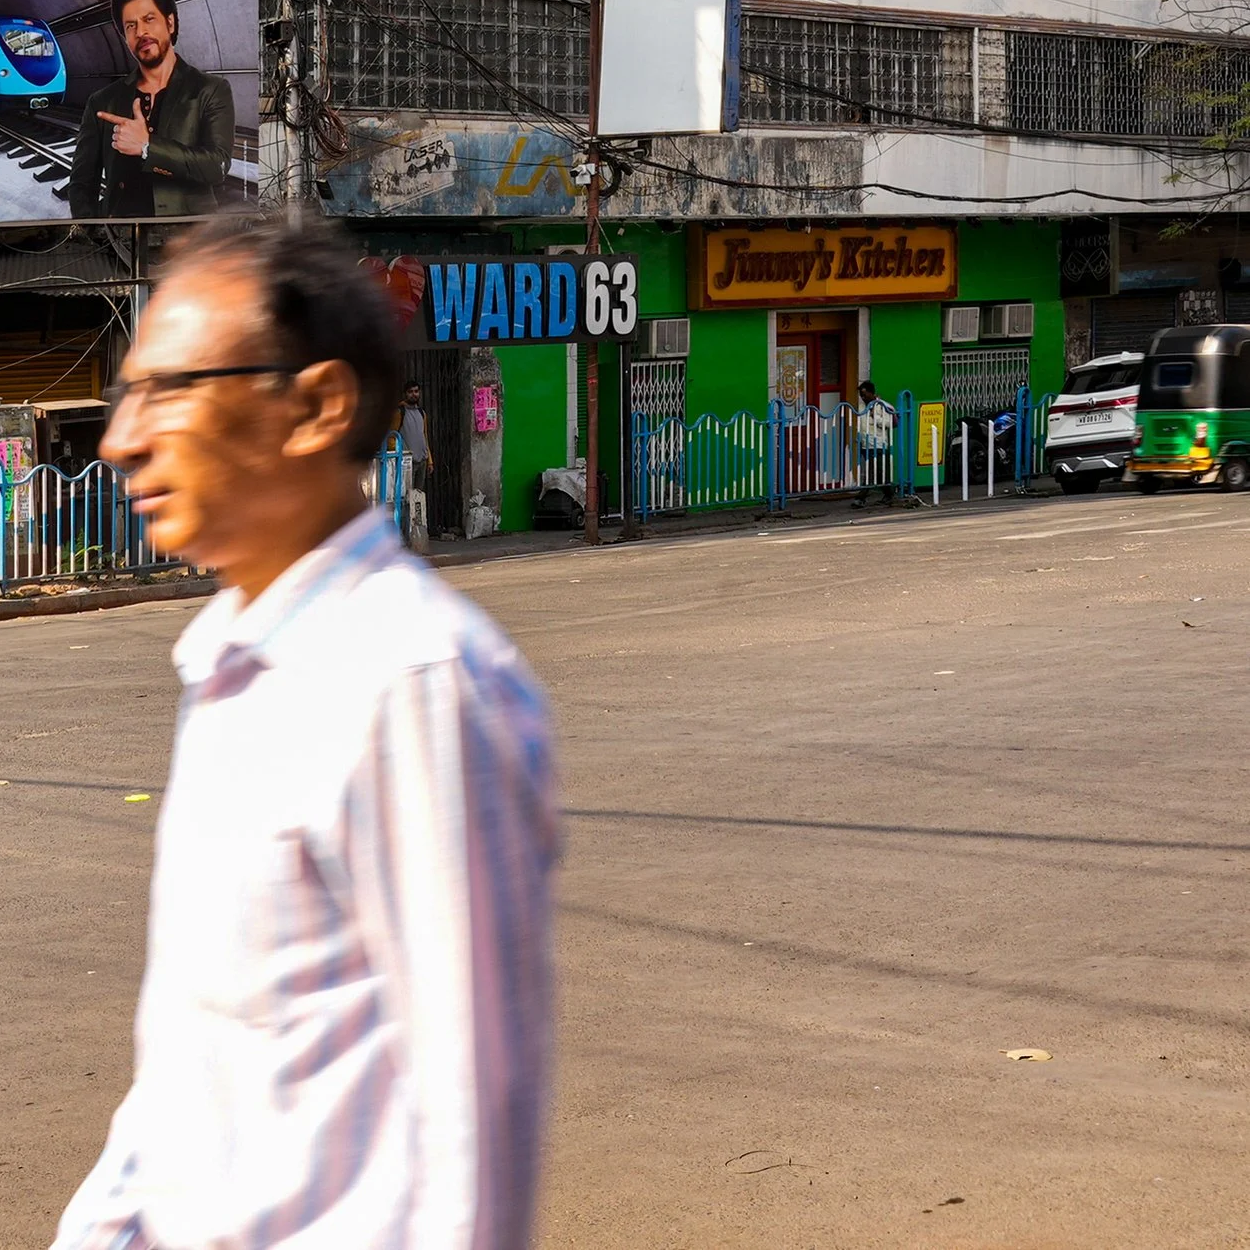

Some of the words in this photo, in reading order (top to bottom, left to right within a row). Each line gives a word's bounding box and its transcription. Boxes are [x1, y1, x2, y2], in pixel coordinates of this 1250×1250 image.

[403, 139, 444, 163] LASER
[713, 236, 834, 291] Jimmy's
[835, 236, 946, 280] Kitchen
[428, 261, 578, 342] WARD
[584, 260, 638, 336] 63
